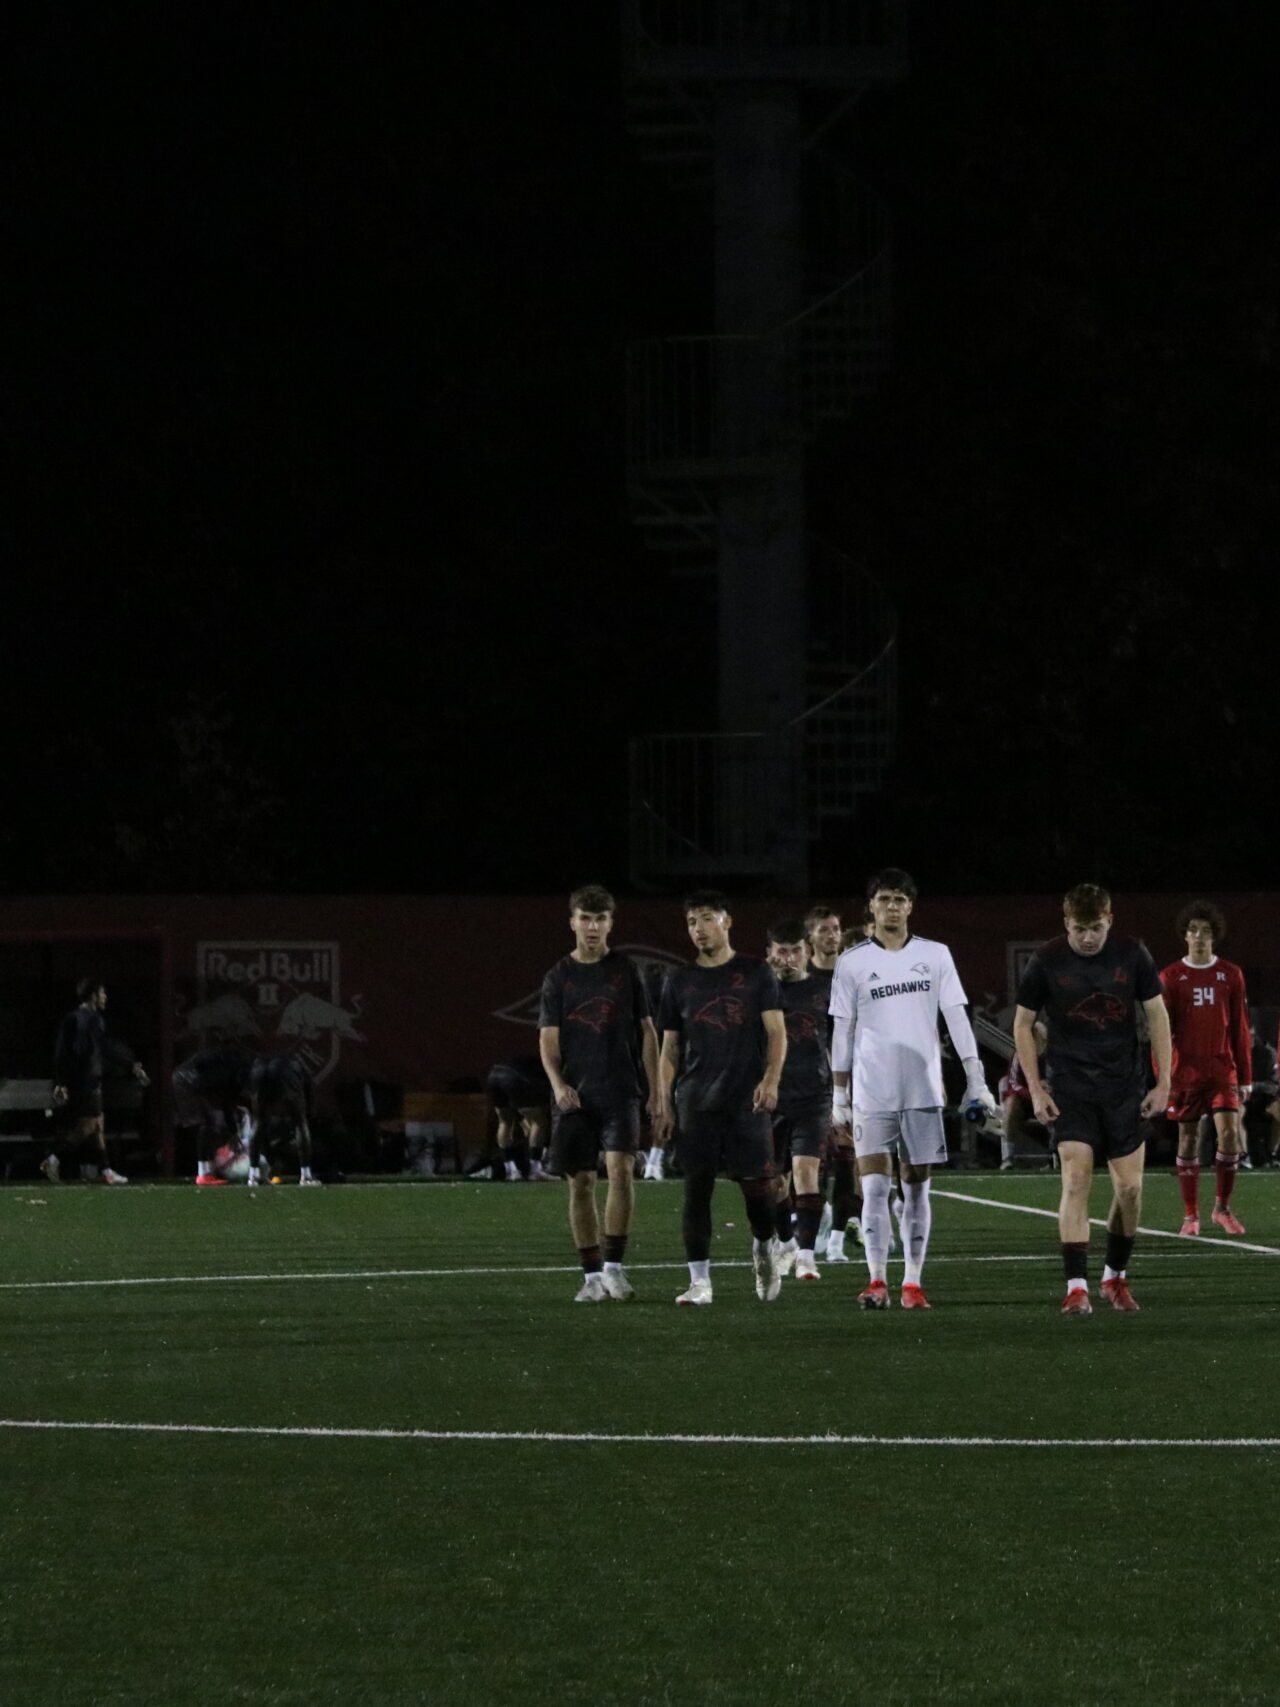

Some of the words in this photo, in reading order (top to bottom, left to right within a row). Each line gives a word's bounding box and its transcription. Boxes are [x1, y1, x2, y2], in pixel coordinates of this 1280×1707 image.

[207, 951, 266, 984] Red
[271, 951, 329, 982] Bull
[1216, 971, 1226, 981] R
[870, 980, 931, 1000] REDHAWKS
[1192, 986, 1215, 1006] 34
